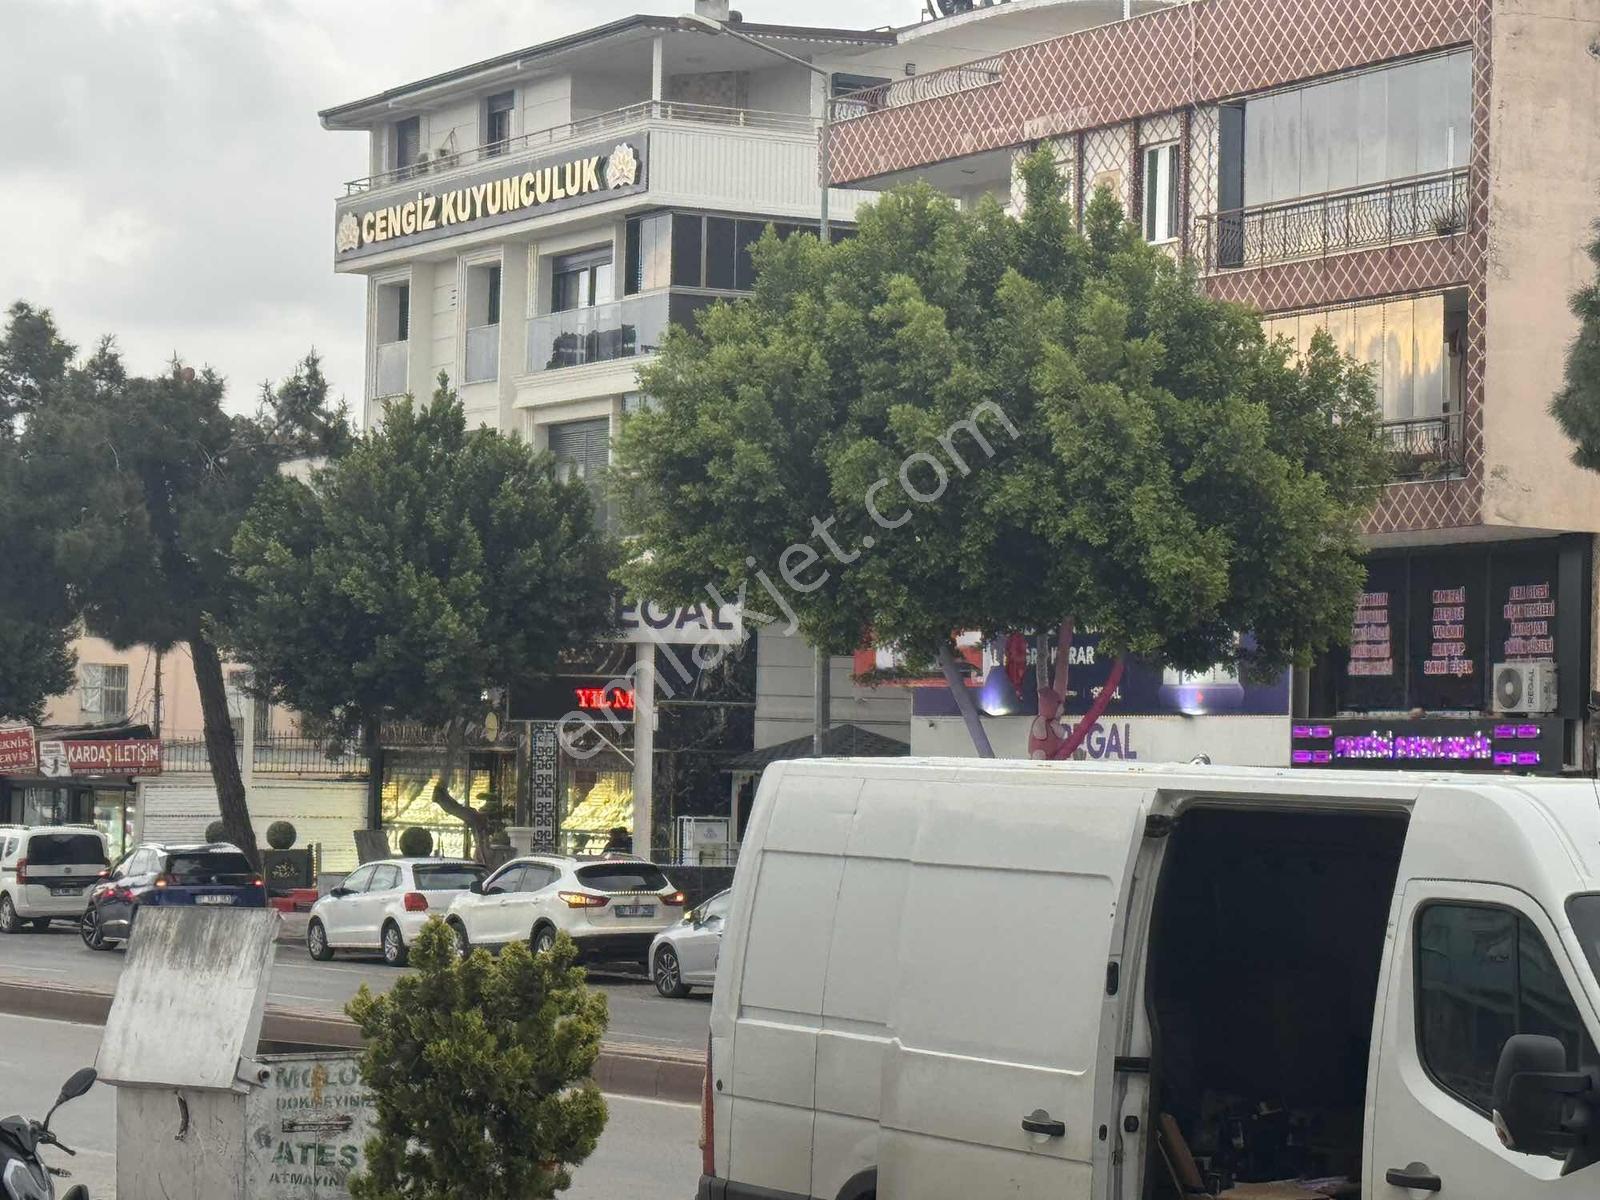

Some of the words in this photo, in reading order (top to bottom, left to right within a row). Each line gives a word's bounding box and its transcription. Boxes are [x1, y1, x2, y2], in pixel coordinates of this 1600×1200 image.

[361, 191, 437, 244] CENGİZ
[441, 156, 600, 226] KUYUMCULUK
[68, 745, 112, 767] KARDAŞ
[114, 743, 159, 766] İLETİŞİM
